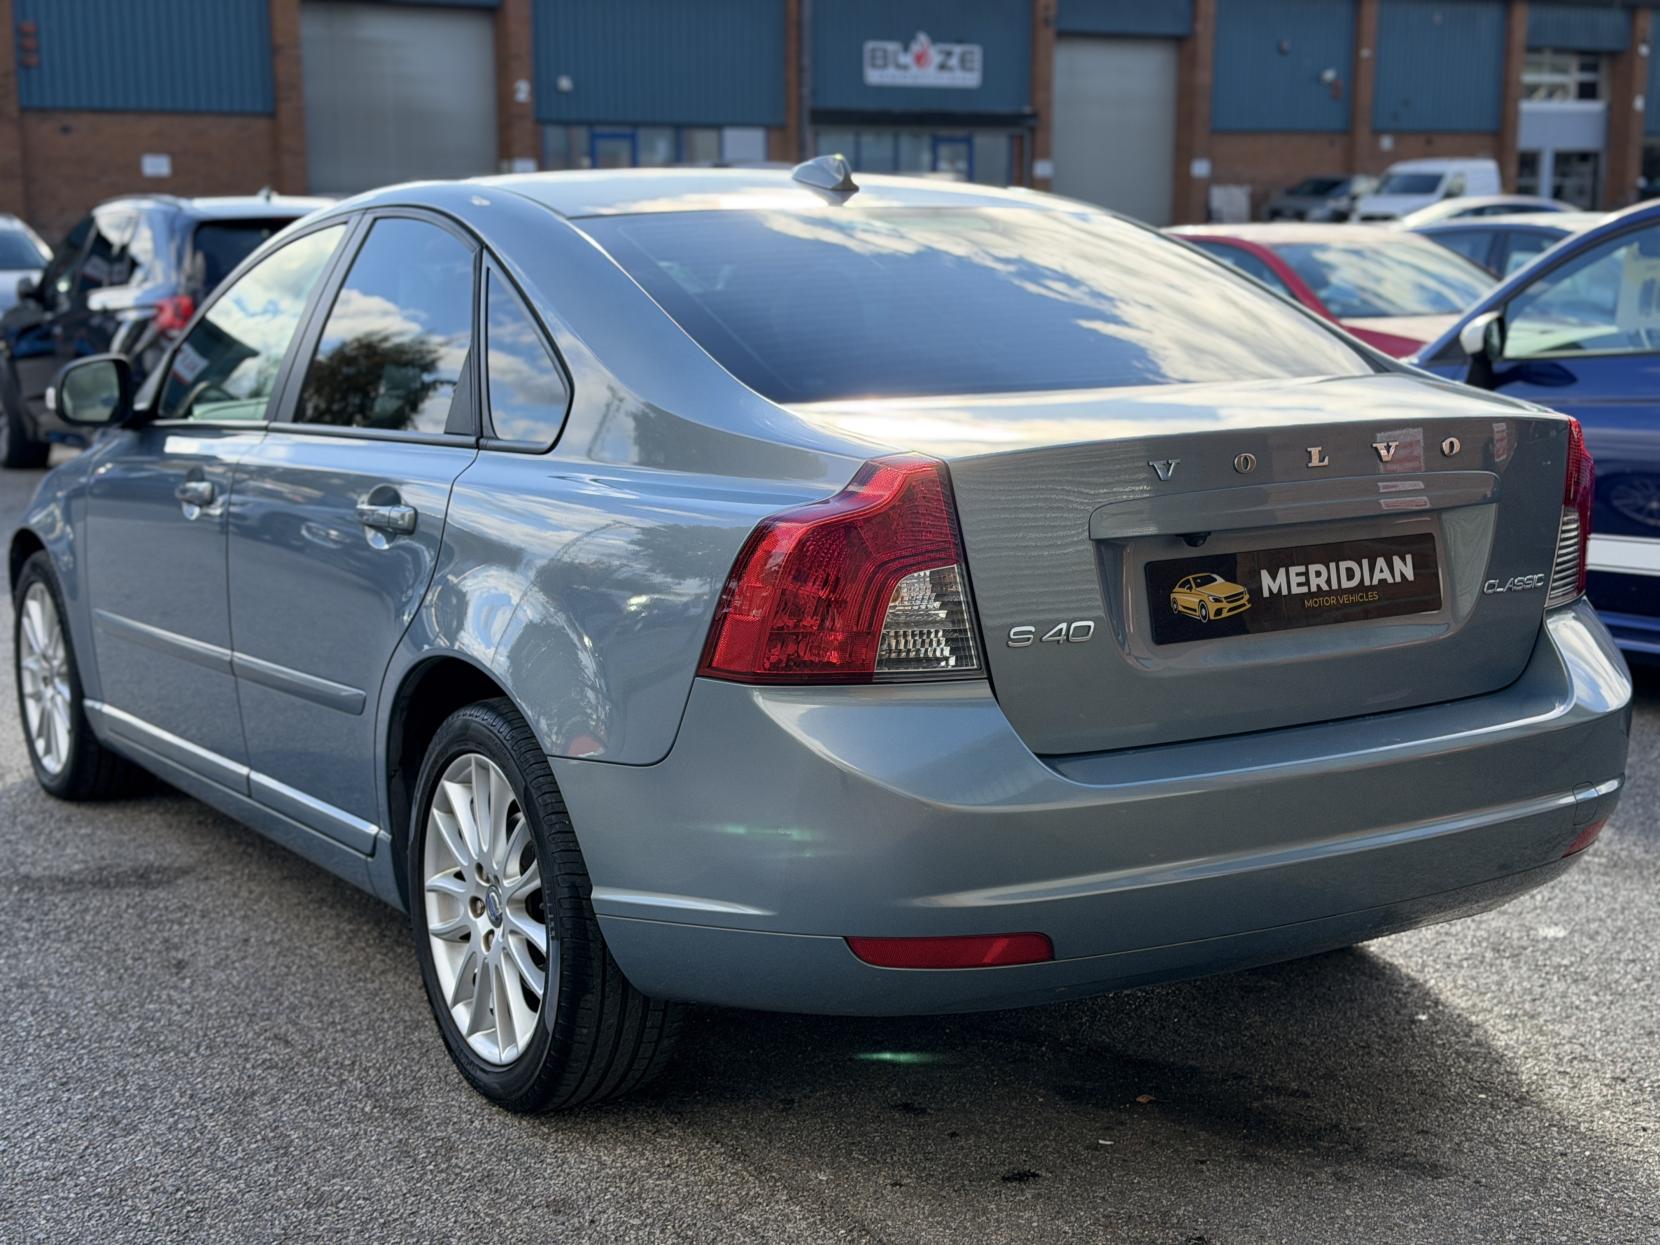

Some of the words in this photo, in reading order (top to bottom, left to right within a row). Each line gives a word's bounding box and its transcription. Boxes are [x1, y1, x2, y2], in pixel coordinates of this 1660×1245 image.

[1149, 436, 1461, 481] VOLVO
[1260, 553, 1415, 598] MERIDIAN
[1483, 573, 1545, 594] CLASSIC
[1304, 595, 1338, 609] MOTOR
[1338, 591, 1380, 605] VEHICLES
